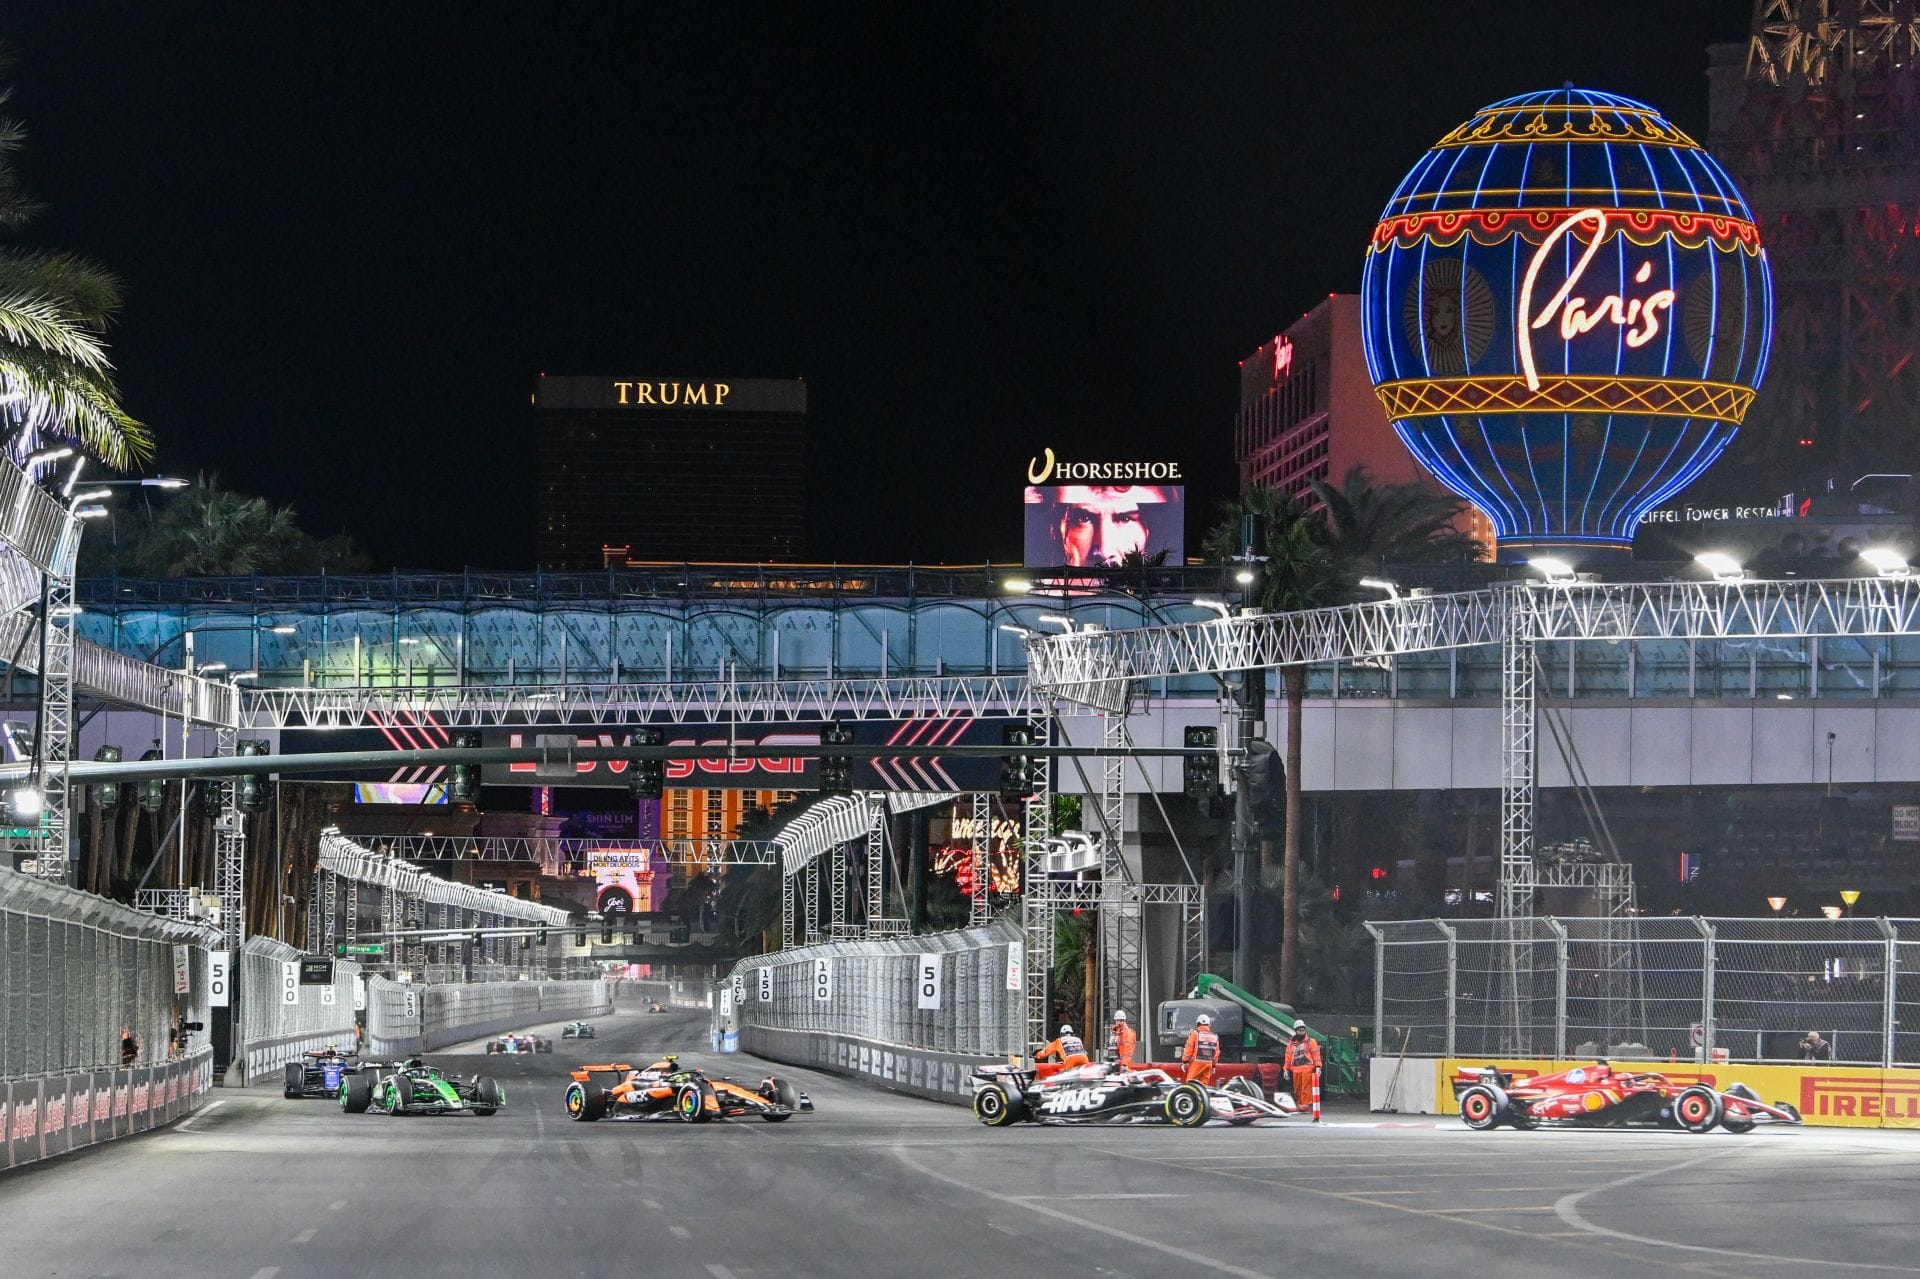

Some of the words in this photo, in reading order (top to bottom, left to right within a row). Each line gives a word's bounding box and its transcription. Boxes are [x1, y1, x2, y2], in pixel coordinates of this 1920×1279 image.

[1518, 208, 1676, 392] Paris
[613, 382, 730, 405] TRUMP
[1686, 507, 1730, 522] TOWER
[212, 964, 224, 995] 50
[285, 964, 295, 1002] 100
[761, 969, 770, 1001] 150
[817, 960, 828, 999] 100
[923, 966, 936, 998] 50
[1041, 1086, 1117, 1114] HAAS
